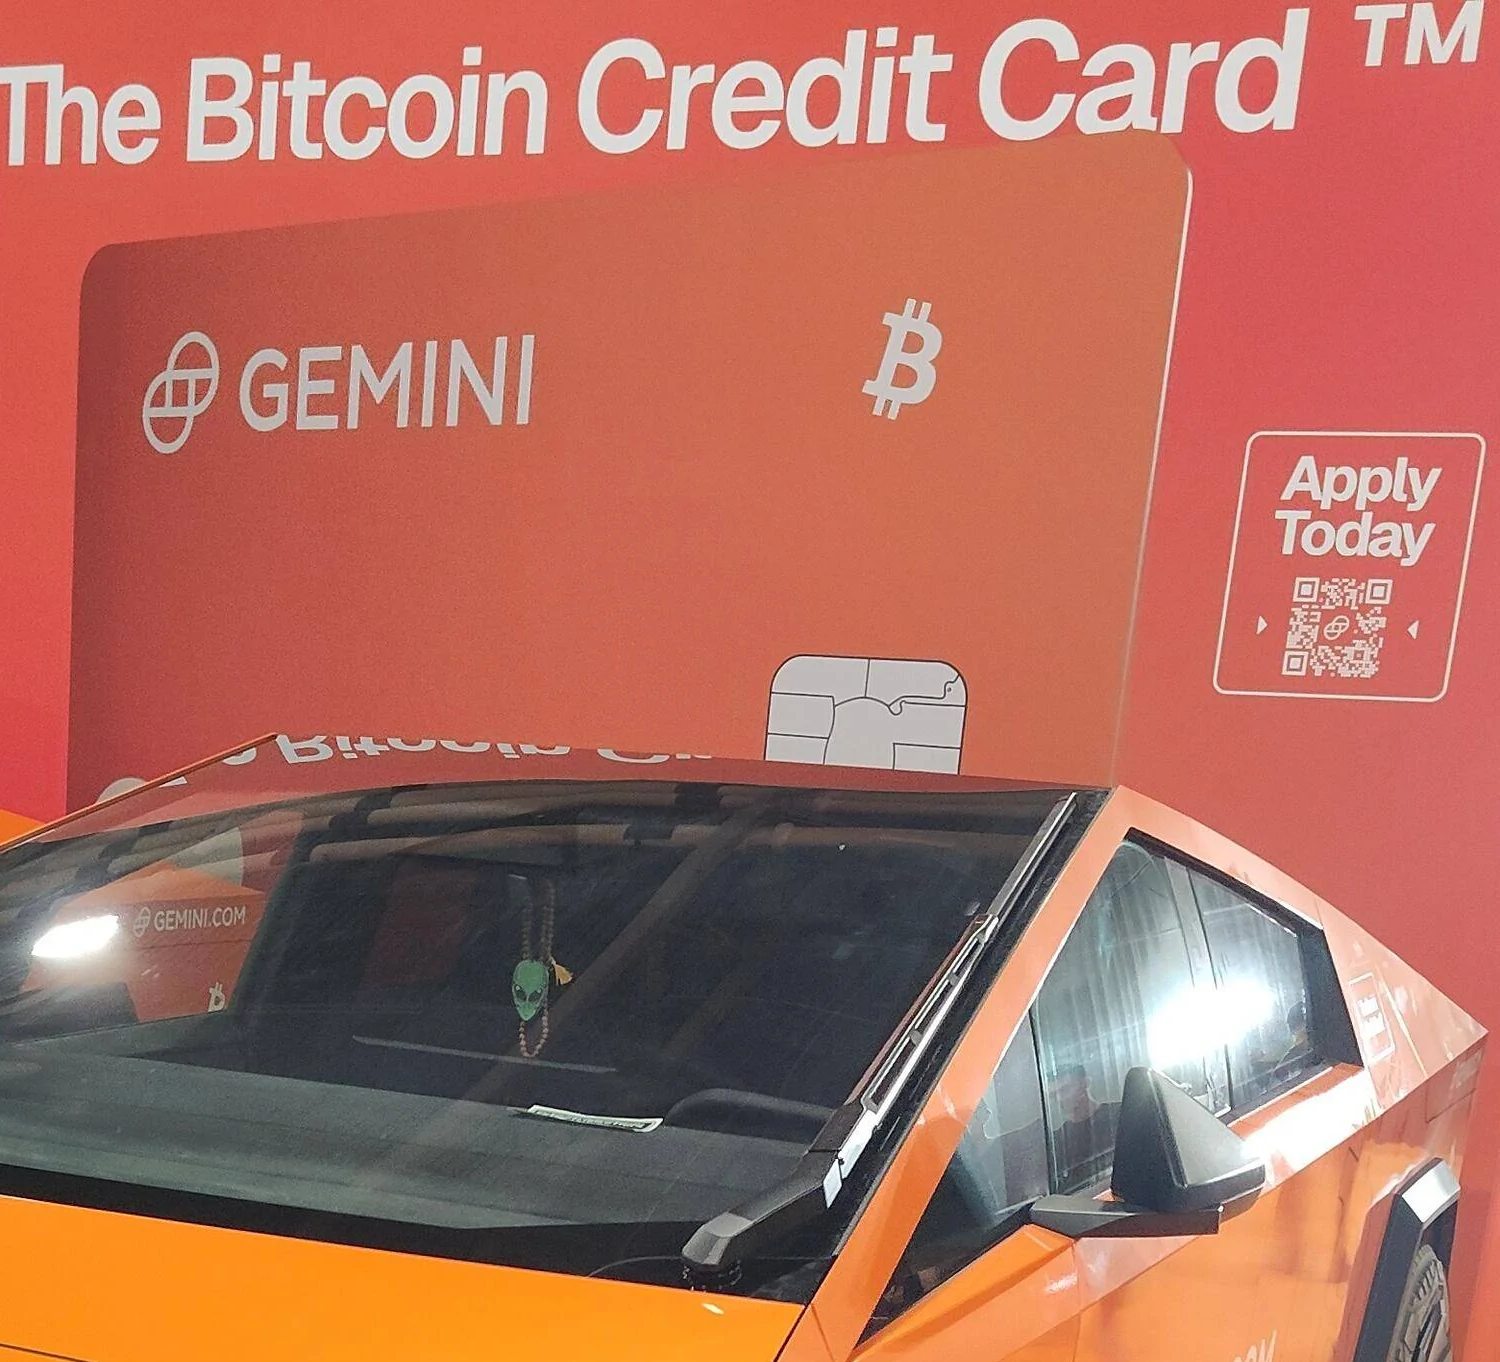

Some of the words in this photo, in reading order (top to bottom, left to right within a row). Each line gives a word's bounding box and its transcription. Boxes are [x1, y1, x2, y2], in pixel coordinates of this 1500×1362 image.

[186, 46, 549, 162] Bitcoin
[577, 27, 953, 155] Credit
[978, 8, 1310, 142] Card
[238, 333, 536, 433] GEMINI
[1280, 455, 1443, 512] Apply
[1274, 509, 1437, 567] Today
[153, 906, 246, 932] GEMINI.COM
